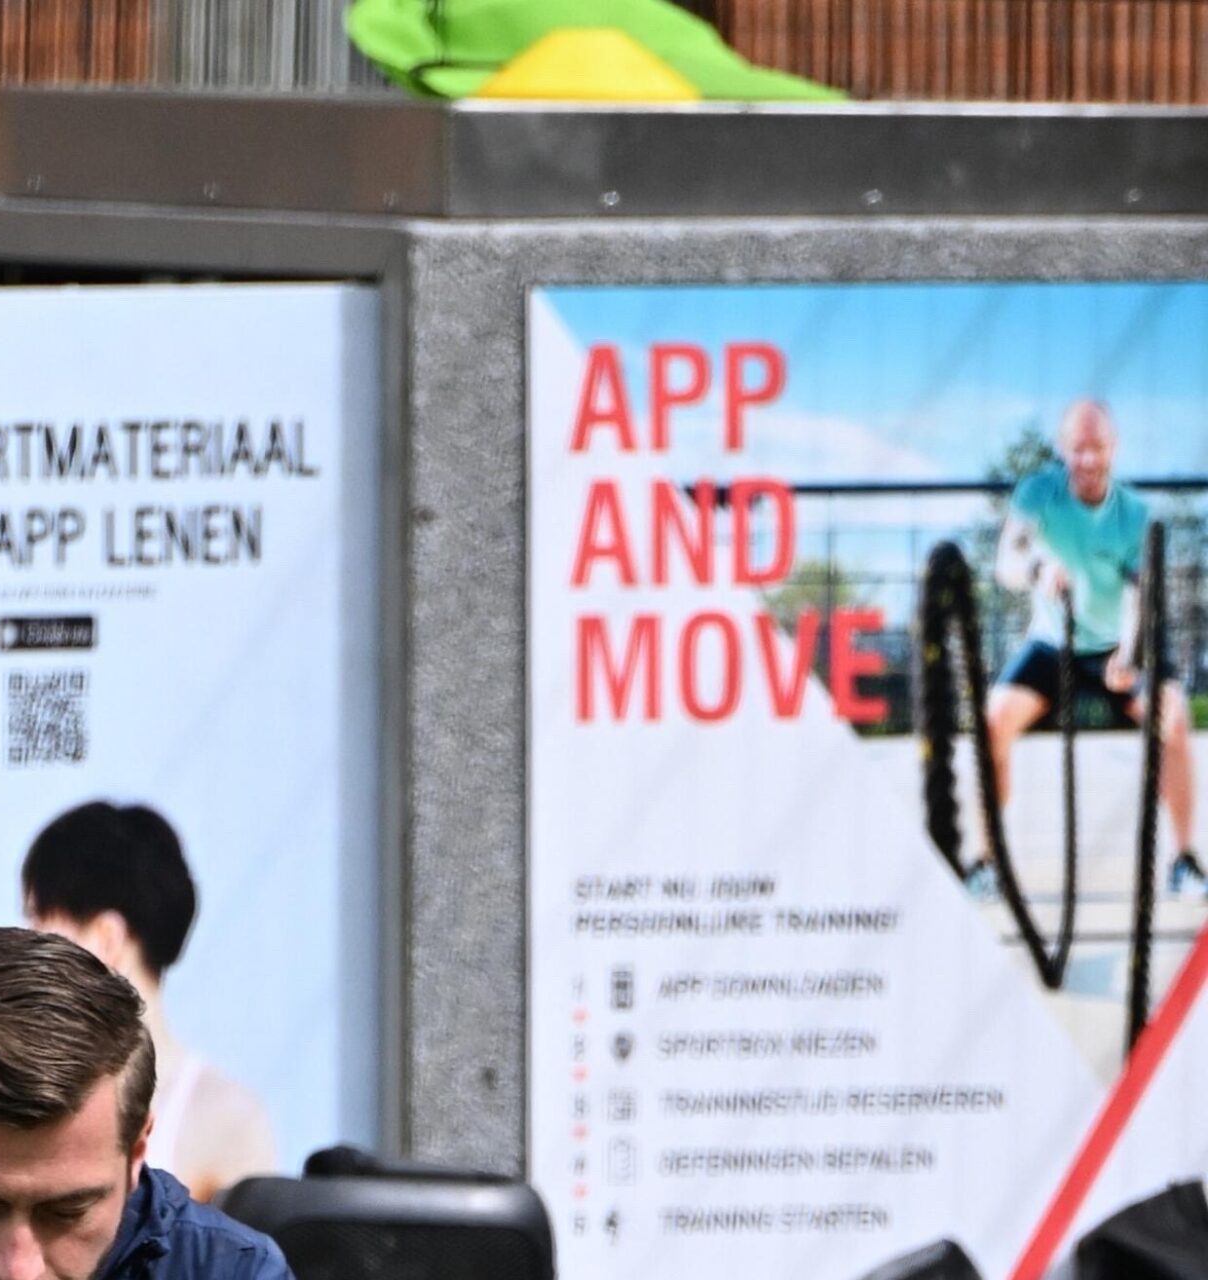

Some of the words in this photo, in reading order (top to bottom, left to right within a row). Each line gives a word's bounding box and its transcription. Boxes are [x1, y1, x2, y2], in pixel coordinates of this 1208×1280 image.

[570, 343, 788, 452] APP
[104, 504, 263, 566] LENEN
[570, 480, 797, 587] AND
[575, 608, 890, 724] MOVE
